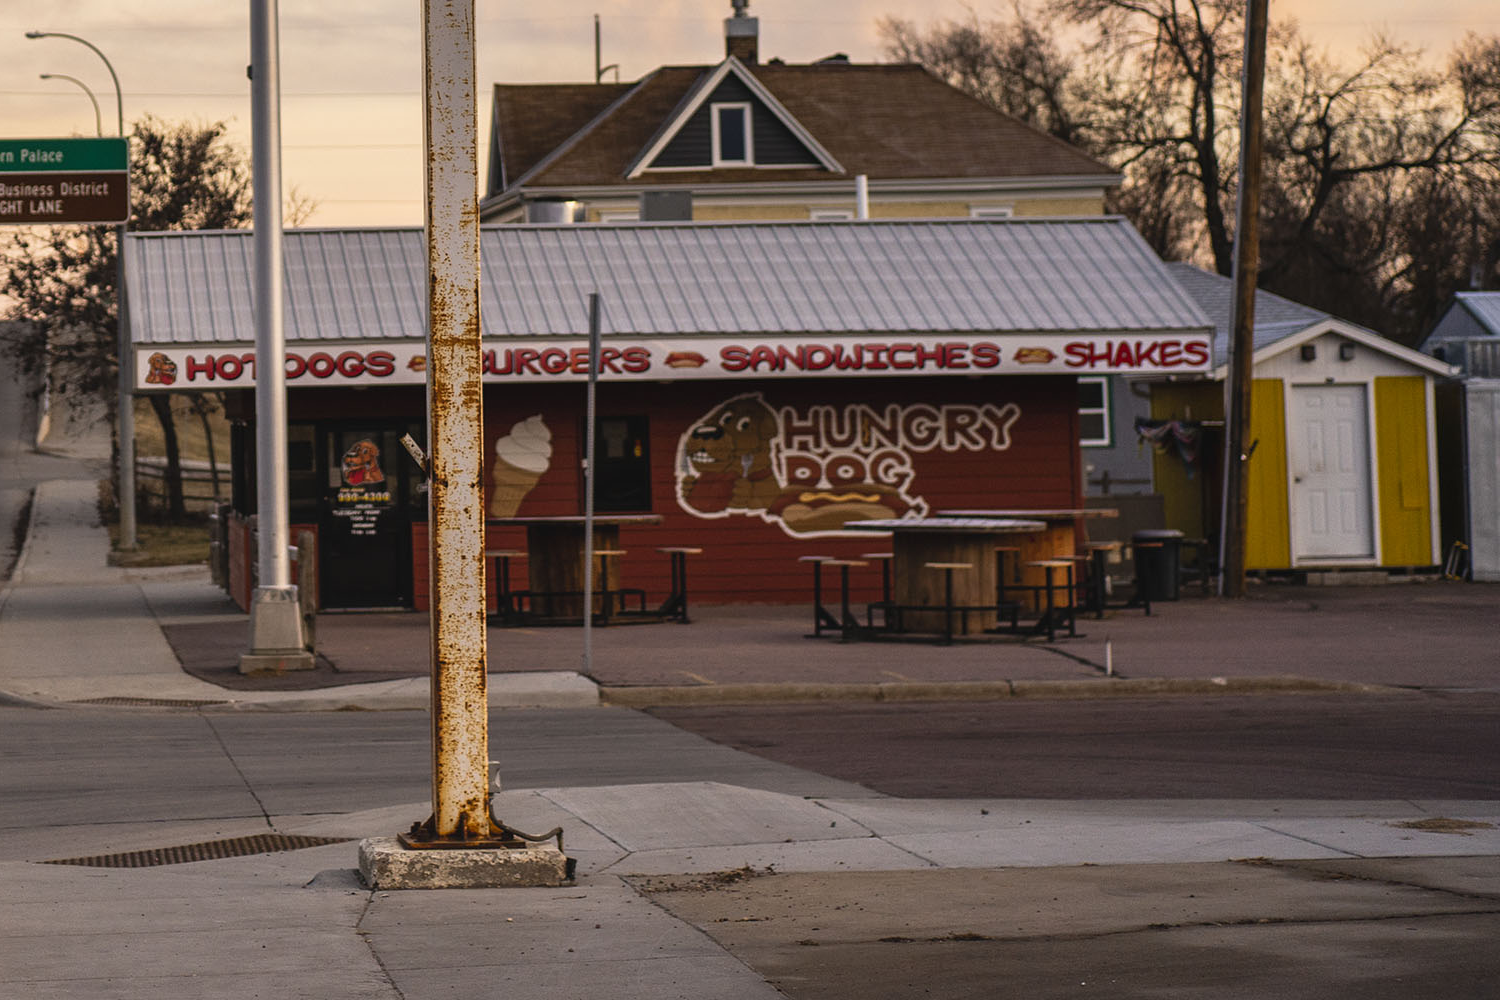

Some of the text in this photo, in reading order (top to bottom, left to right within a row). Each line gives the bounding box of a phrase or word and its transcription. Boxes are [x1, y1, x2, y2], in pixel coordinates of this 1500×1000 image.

[20, 148, 64, 163] Palace
[60, 181, 109, 196] District
[29, 199, 64, 214] LANE
[721, 341, 1002, 374] SANDWICHES
[1064, 339, 1211, 369] SHAKES
[780, 402, 1021, 454] HUNGRY
[780, 448, 915, 491] DOG
